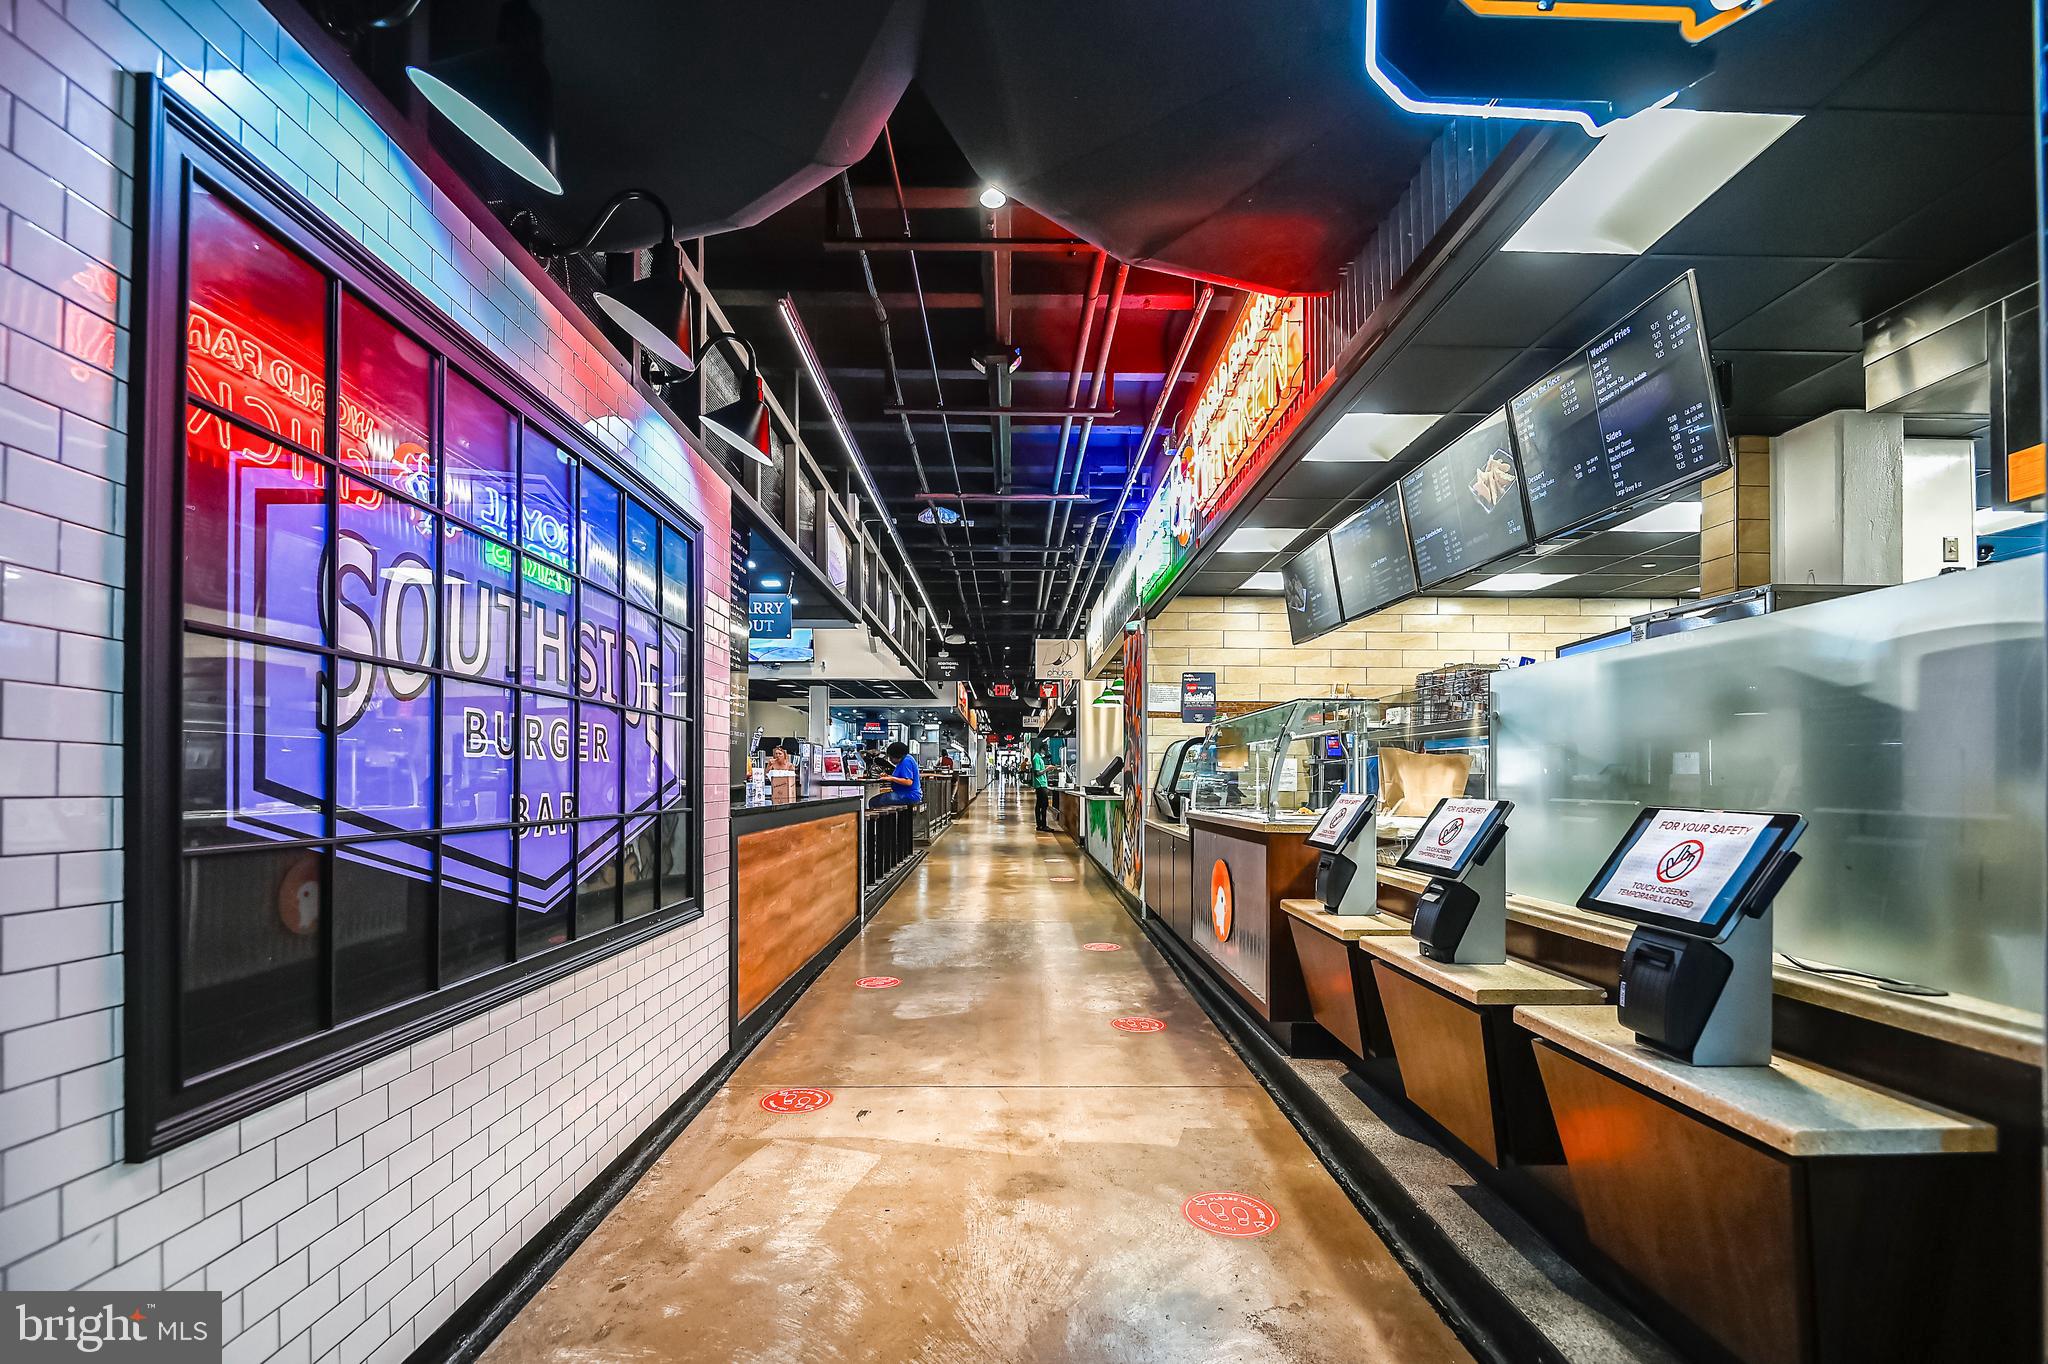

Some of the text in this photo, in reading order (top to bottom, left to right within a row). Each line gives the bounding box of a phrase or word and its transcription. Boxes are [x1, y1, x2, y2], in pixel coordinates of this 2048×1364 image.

[1590, 326, 1632, 358] Western Fries
[1605, 429, 1622, 443] Sides
[1527, 470, 1545, 484] Dessert
[317, 529, 664, 760] SOUTHSIDE
[995, 684, 1010, 697] EXIT
[463, 706, 611, 763] BURGER
[509, 793, 576, 839] BAR
[1446, 805, 1489, 815] FOR YOUR SAFETY
[1659, 820, 1753, 836] FOR YOUR SAFETY
[1632, 881, 1690, 898] TOUCH SCREENS
[1617, 887, 1695, 910] TEMPORARILY CLOSED
[1196, 1214, 1218, 1228] THANK
